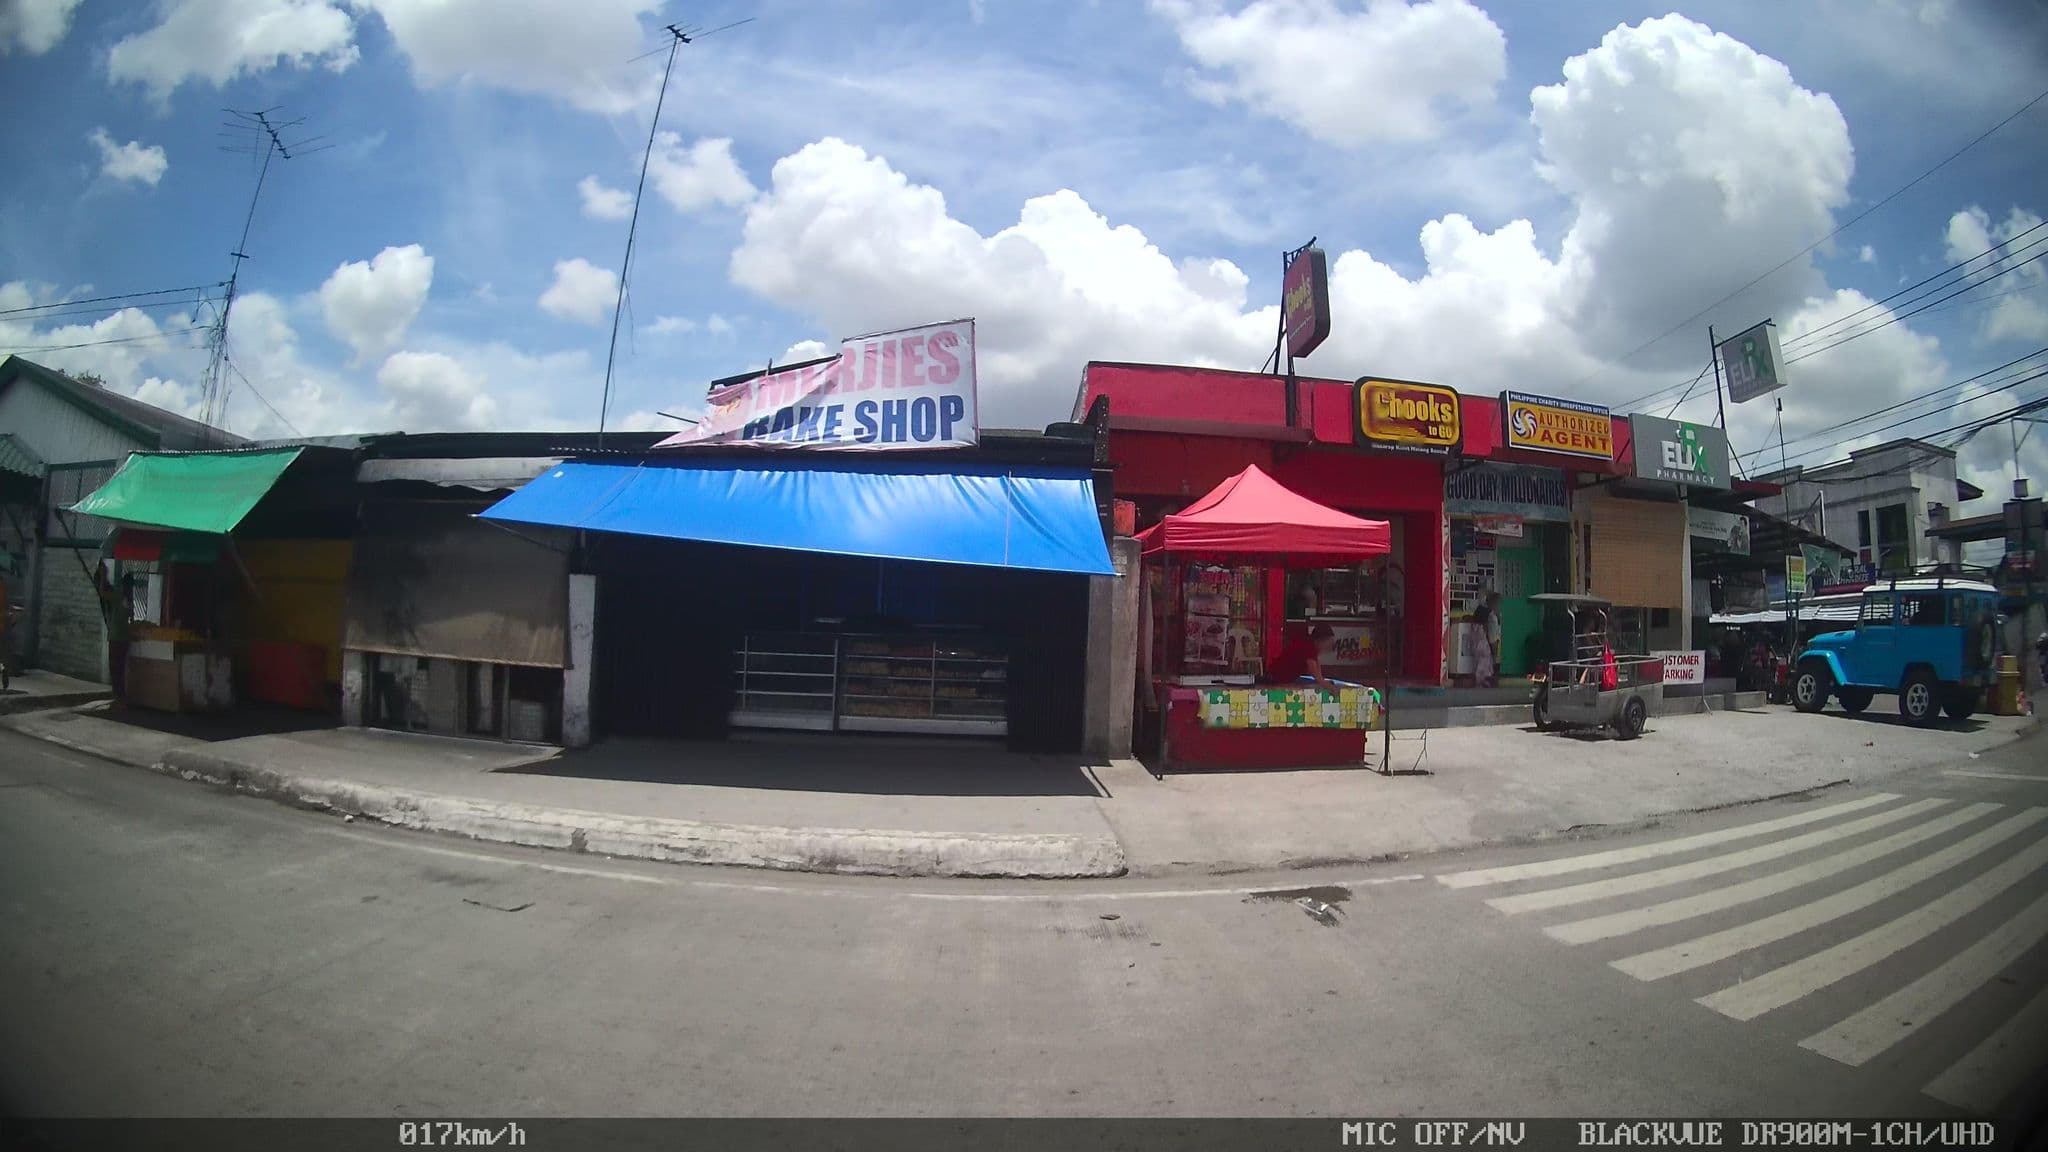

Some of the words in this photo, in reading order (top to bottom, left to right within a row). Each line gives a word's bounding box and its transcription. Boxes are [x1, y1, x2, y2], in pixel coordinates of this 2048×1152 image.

[1375, 391, 1452, 423] Chooks
[1538, 398, 1559, 408] CHARITY
[853, 394, 964, 443] SHOP
[1539, 413, 1609, 435] AUTHORIZED
[1428, 426, 1438, 435] to
[1540, 430, 1609, 451] AGENT
[1447, 471, 1477, 500] GOOD
[1656, 470, 1715, 485] PHARMACY
[1664, 654, 1699, 665] USTOMER
[1664, 669, 1694, 680] ARKING
